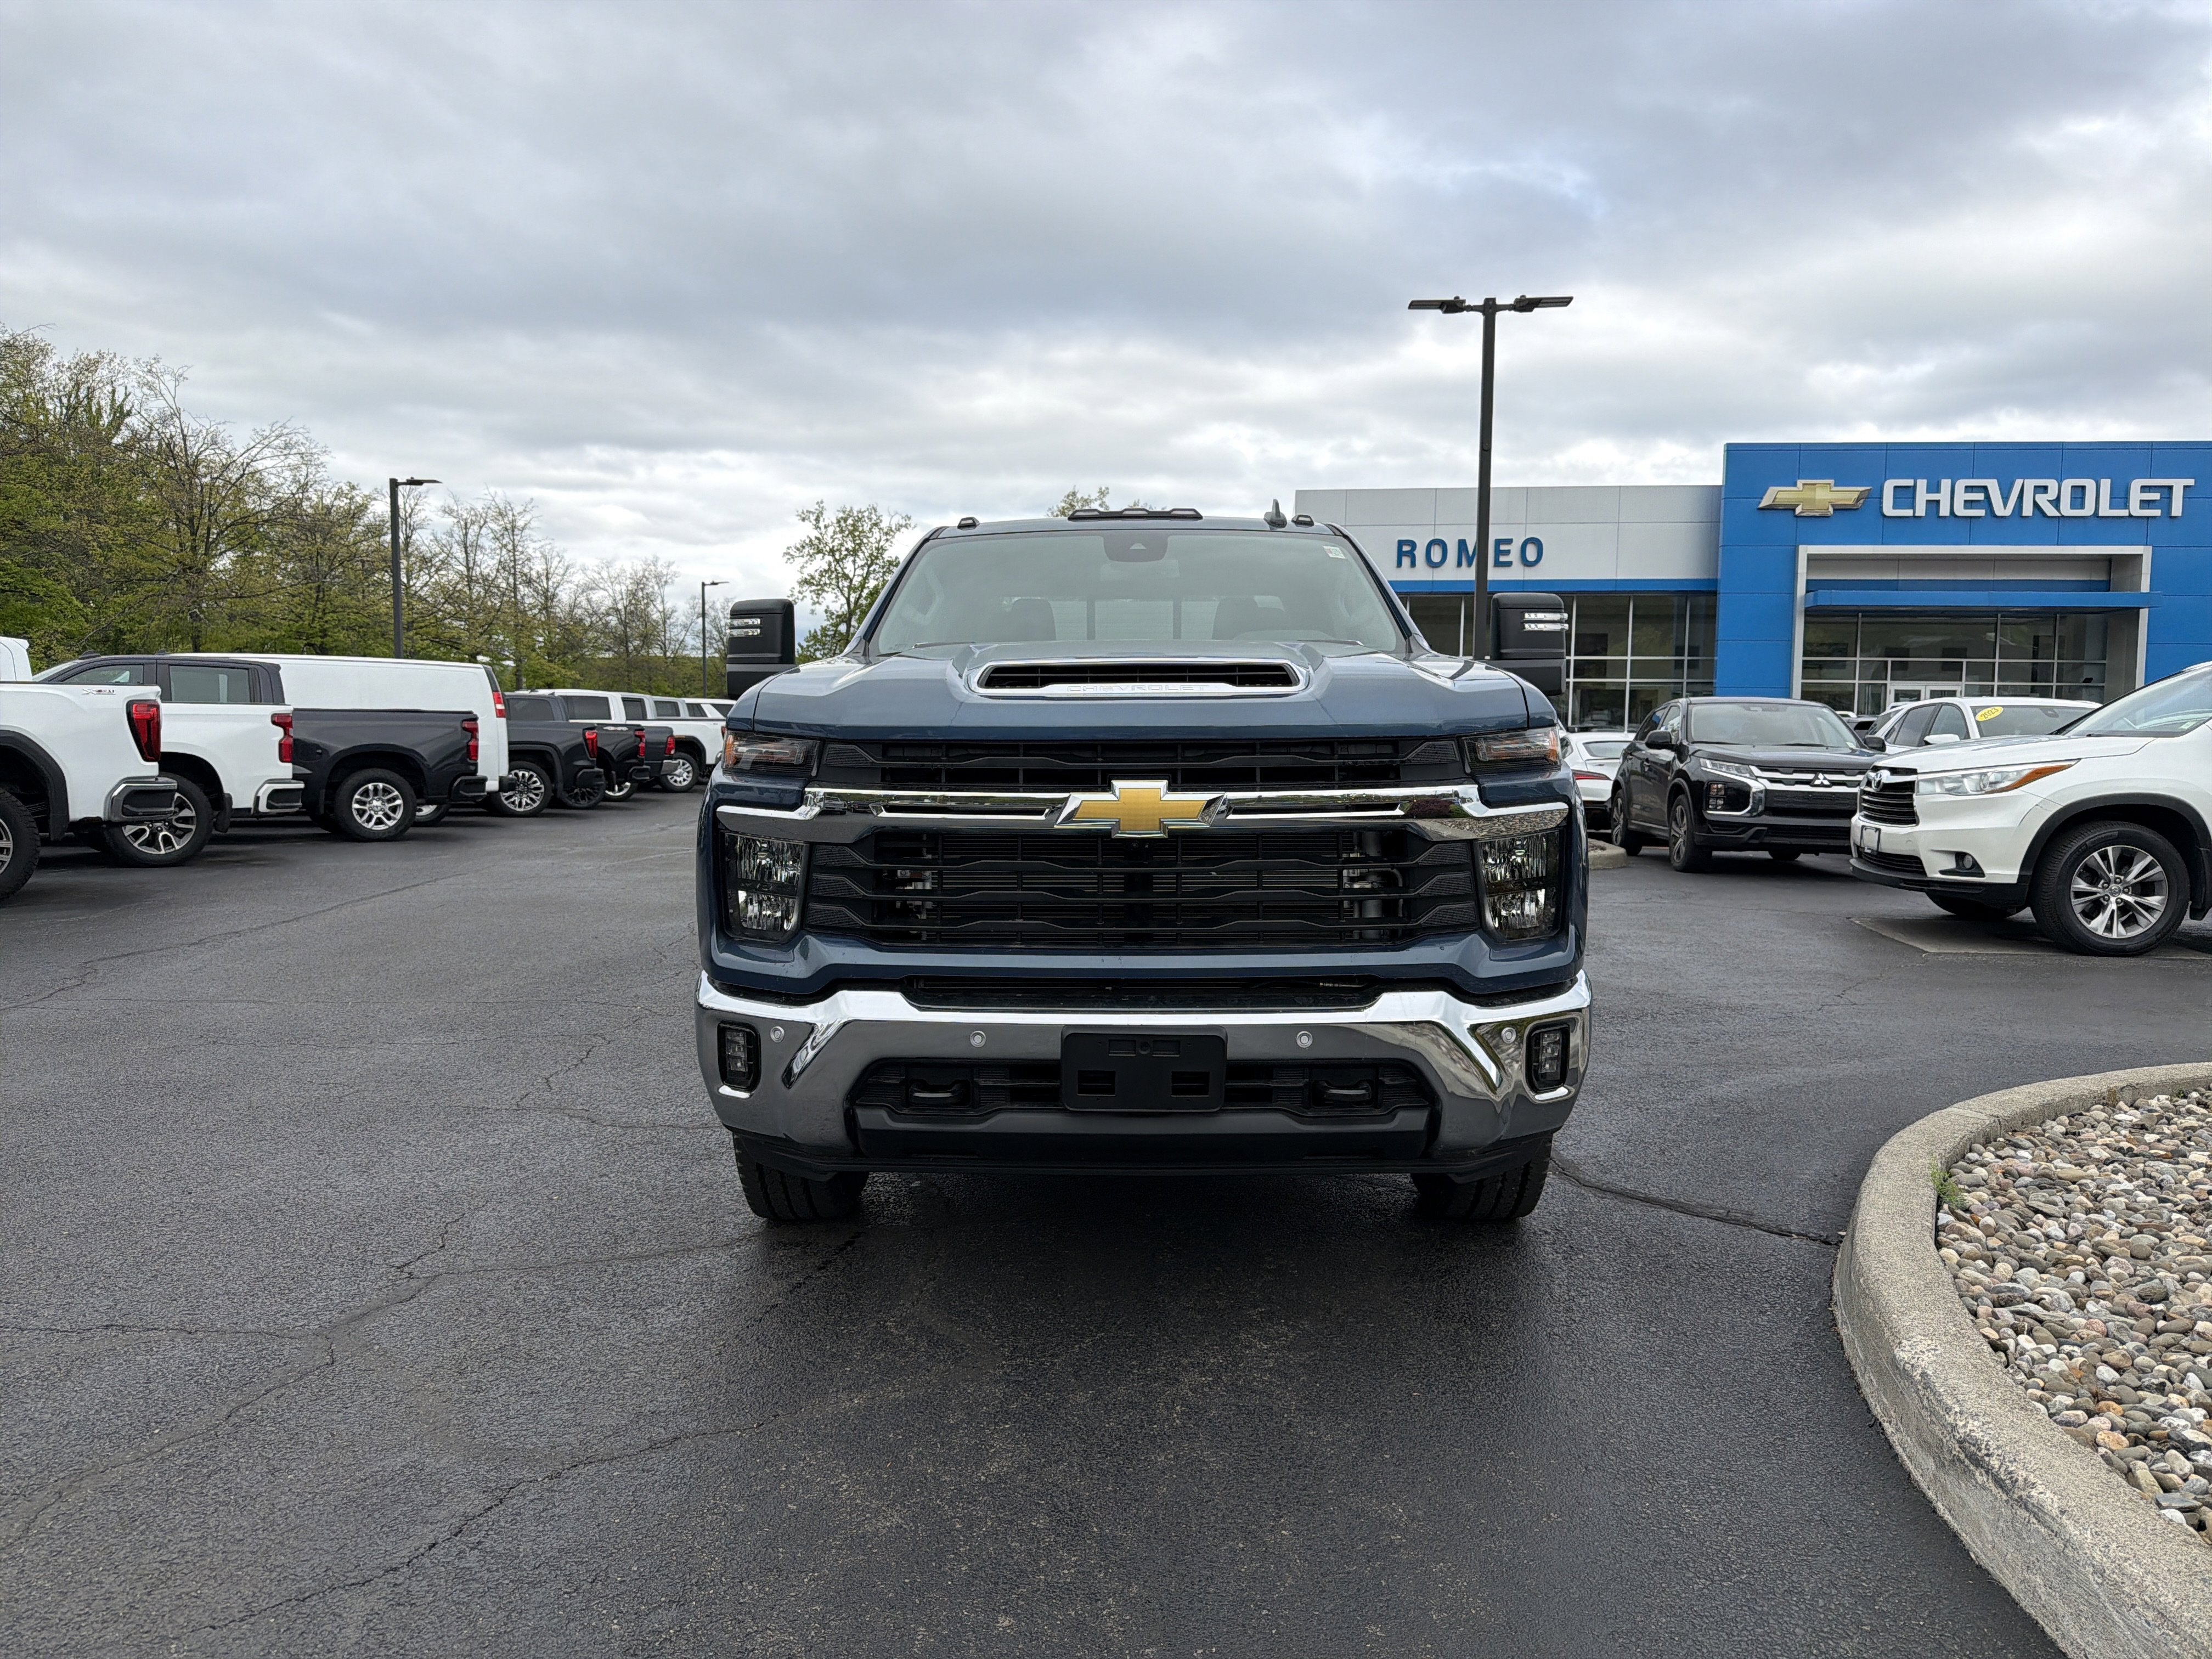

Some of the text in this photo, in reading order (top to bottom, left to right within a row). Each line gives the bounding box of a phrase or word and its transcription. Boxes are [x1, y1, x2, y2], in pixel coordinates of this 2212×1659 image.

[1882, 478, 2195, 517] CHEVROLET
[1396, 537, 1543, 568] ROMEO
[1980, 708, 1999, 719] 2023
